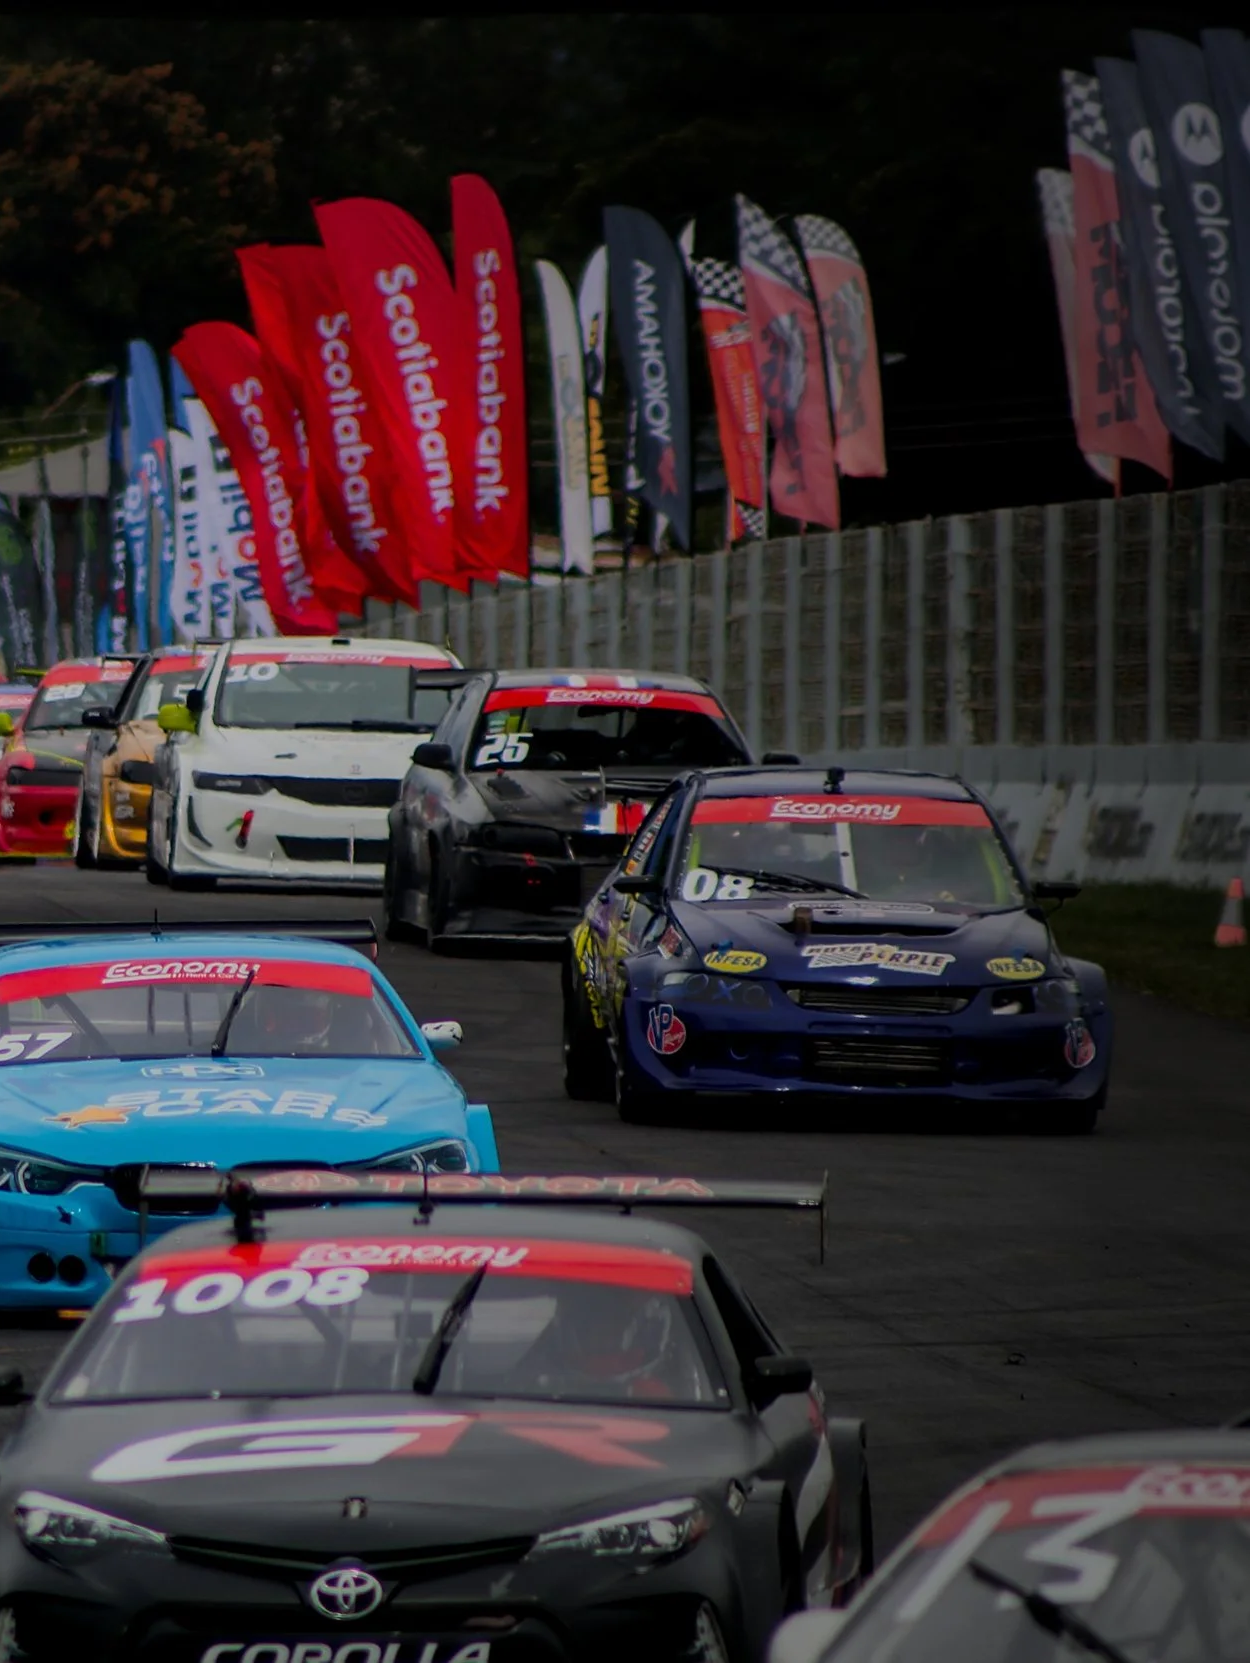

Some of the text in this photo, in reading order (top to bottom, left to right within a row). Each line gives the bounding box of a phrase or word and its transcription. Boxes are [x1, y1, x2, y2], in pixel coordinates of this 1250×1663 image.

[375, 262, 455, 524] Scotiabank
[473, 247, 510, 515] Scotiabank
[314, 310, 390, 555] Scotiabank
[230, 375, 318, 614] Scotiabank
[225, 661, 280, 683] 10
[545, 688, 655, 705] Economy
[473, 732, 534, 768] 25
[770, 799, 902, 821] Economy
[681, 867, 756, 901] 08
[101, 961, 261, 984] Economy
[705, 953, 763, 968] INFESA
[103, 1088, 338, 1109] STAR
[366, 1173, 716, 1198] TOYOTA
[291, 1243, 529, 1270] Economy
[112, 1266, 370, 1324] 1008
[91, 1411, 674, 1483] GR
